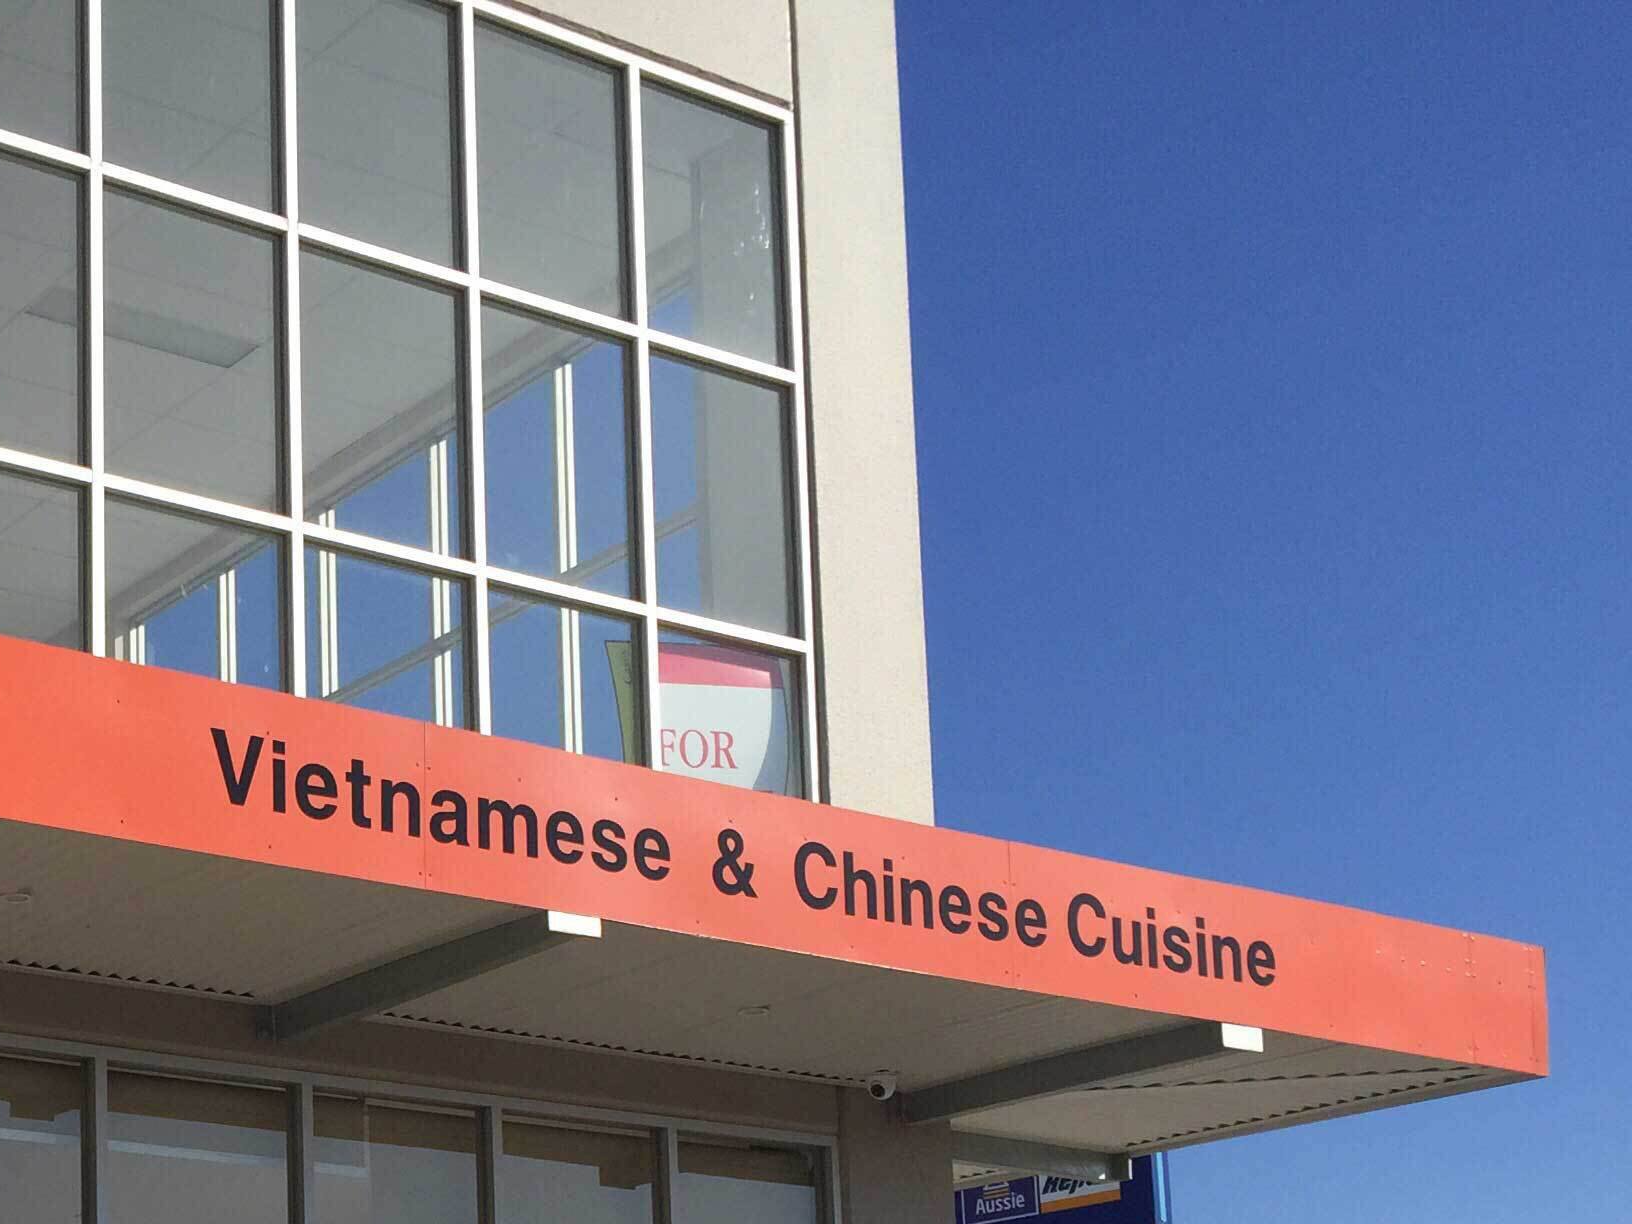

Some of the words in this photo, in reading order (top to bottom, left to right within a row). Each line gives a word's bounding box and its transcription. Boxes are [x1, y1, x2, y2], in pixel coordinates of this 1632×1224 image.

[660, 729, 738, 769] FOR
[210, 727, 671, 881] Vietnamese
[711, 828, 759, 898] &
[793, 841, 1048, 948] Chinese
[1067, 892, 1276, 987] Cuisine
[975, 1191, 1025, 1215] Aussie
